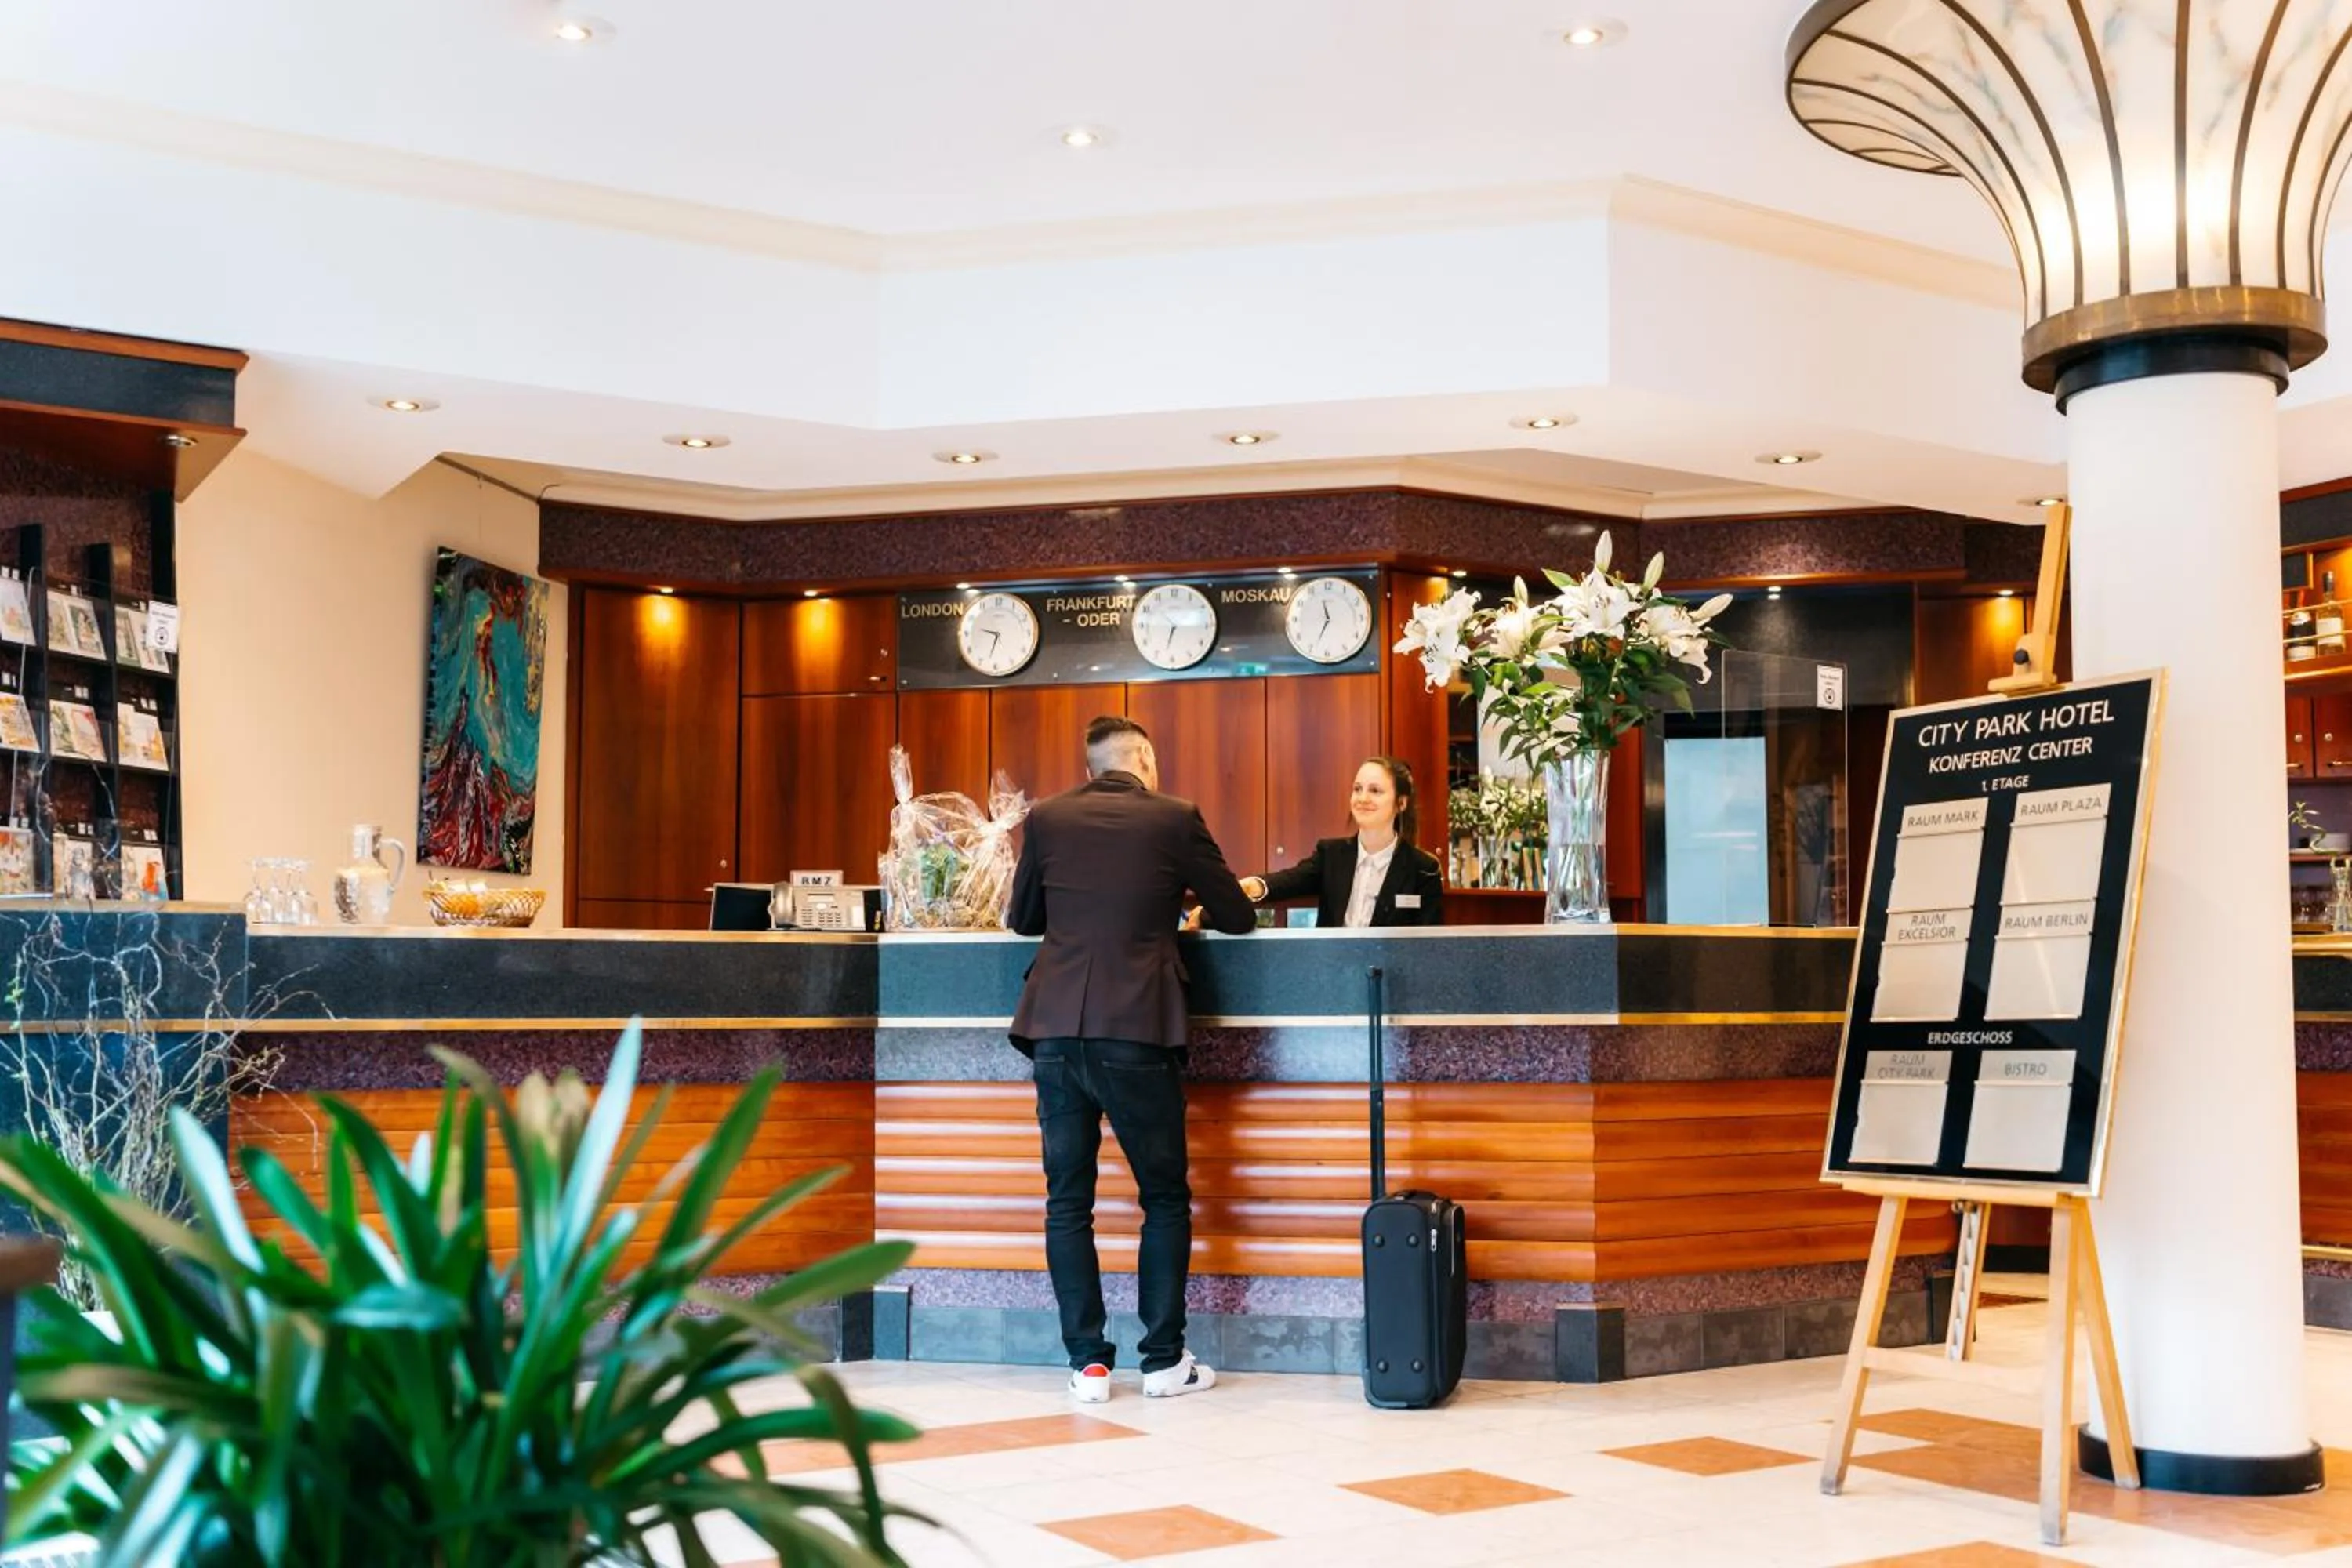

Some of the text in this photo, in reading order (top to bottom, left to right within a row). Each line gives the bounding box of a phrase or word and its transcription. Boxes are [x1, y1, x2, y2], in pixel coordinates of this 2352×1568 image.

[1047, 594, 1136, 612] FRANKFURT
[1221, 588, 1290, 603] MOSKAU
[902, 602, 964, 619] LONDON
[1076, 612, 1120, 626] ODER
[1918, 699, 2114, 747] CITY PARK HOTEL
[1929, 736, 2093, 774] KONFERENZ CENTER
[1992, 775, 2030, 791] ETAGE
[2020, 797, 2103, 817] RAUM PLAZA
[1907, 811, 1980, 828] RAUM MARK
[1911, 913, 1947, 926] RAUM
[2005, 913, 2089, 930] RAUM BERLIN
[1898, 926, 1956, 940] EXCELSIOR
[1927, 1031, 2013, 1045] ERDGESCHOSS
[1891, 1054, 1926, 1065] RAUM
[2004, 1062, 2048, 1077] BISTRO
